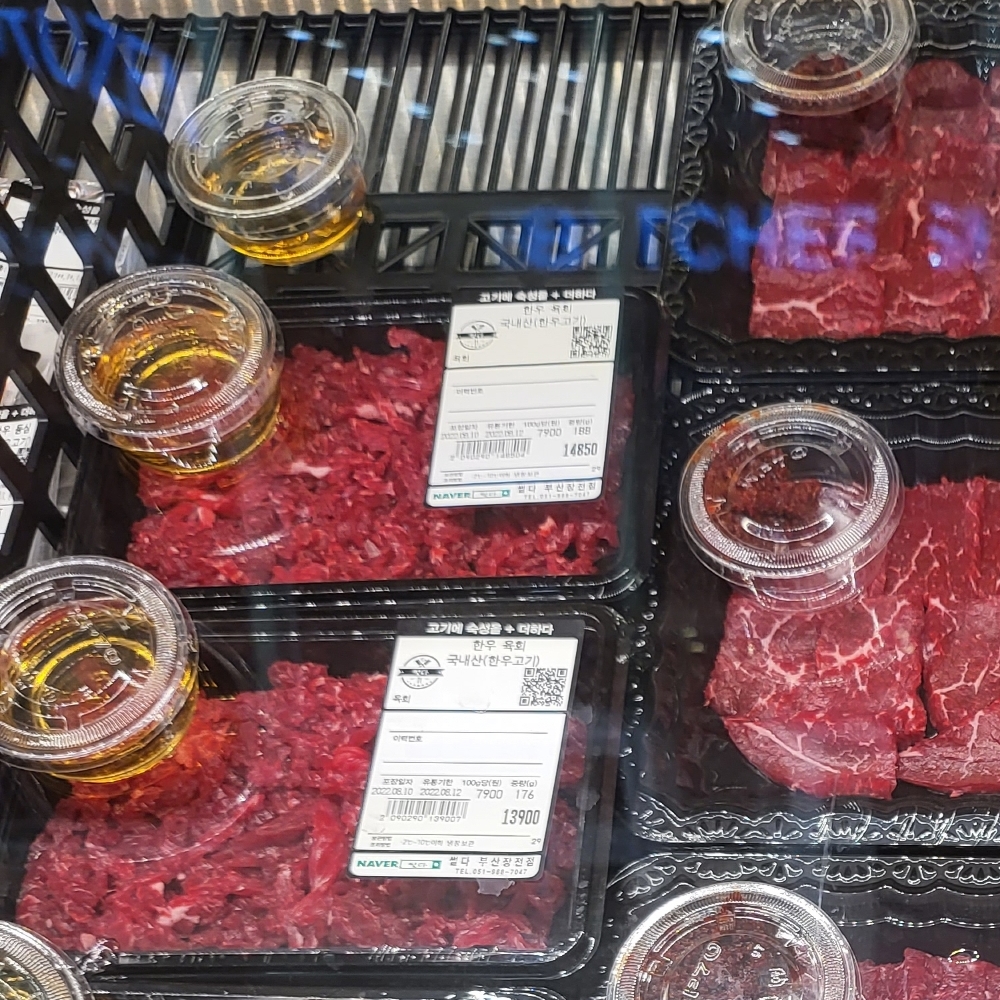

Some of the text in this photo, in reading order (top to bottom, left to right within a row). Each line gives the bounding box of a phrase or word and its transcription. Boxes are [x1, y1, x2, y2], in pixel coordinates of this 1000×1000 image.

[537, 429, 562, 437] 7900
[563, 443, 597, 457] 14850
[426, 622, 463, 635] 고기에
[465, 623, 502, 635] 숙성을
[517, 623, 554, 635] 더하다
[473, 640, 526, 651] 한우 육회
[447, 655, 540, 667] 국내산(한우고기)
[393, 695, 411, 703] 육회
[477, 789, 503, 799] 7900
[515, 790, 534, 799] 176
[502, 809, 540, 825] 13900
[357, 860, 398, 868] NAVER
[479, 857, 535, 867] 부산장전점
